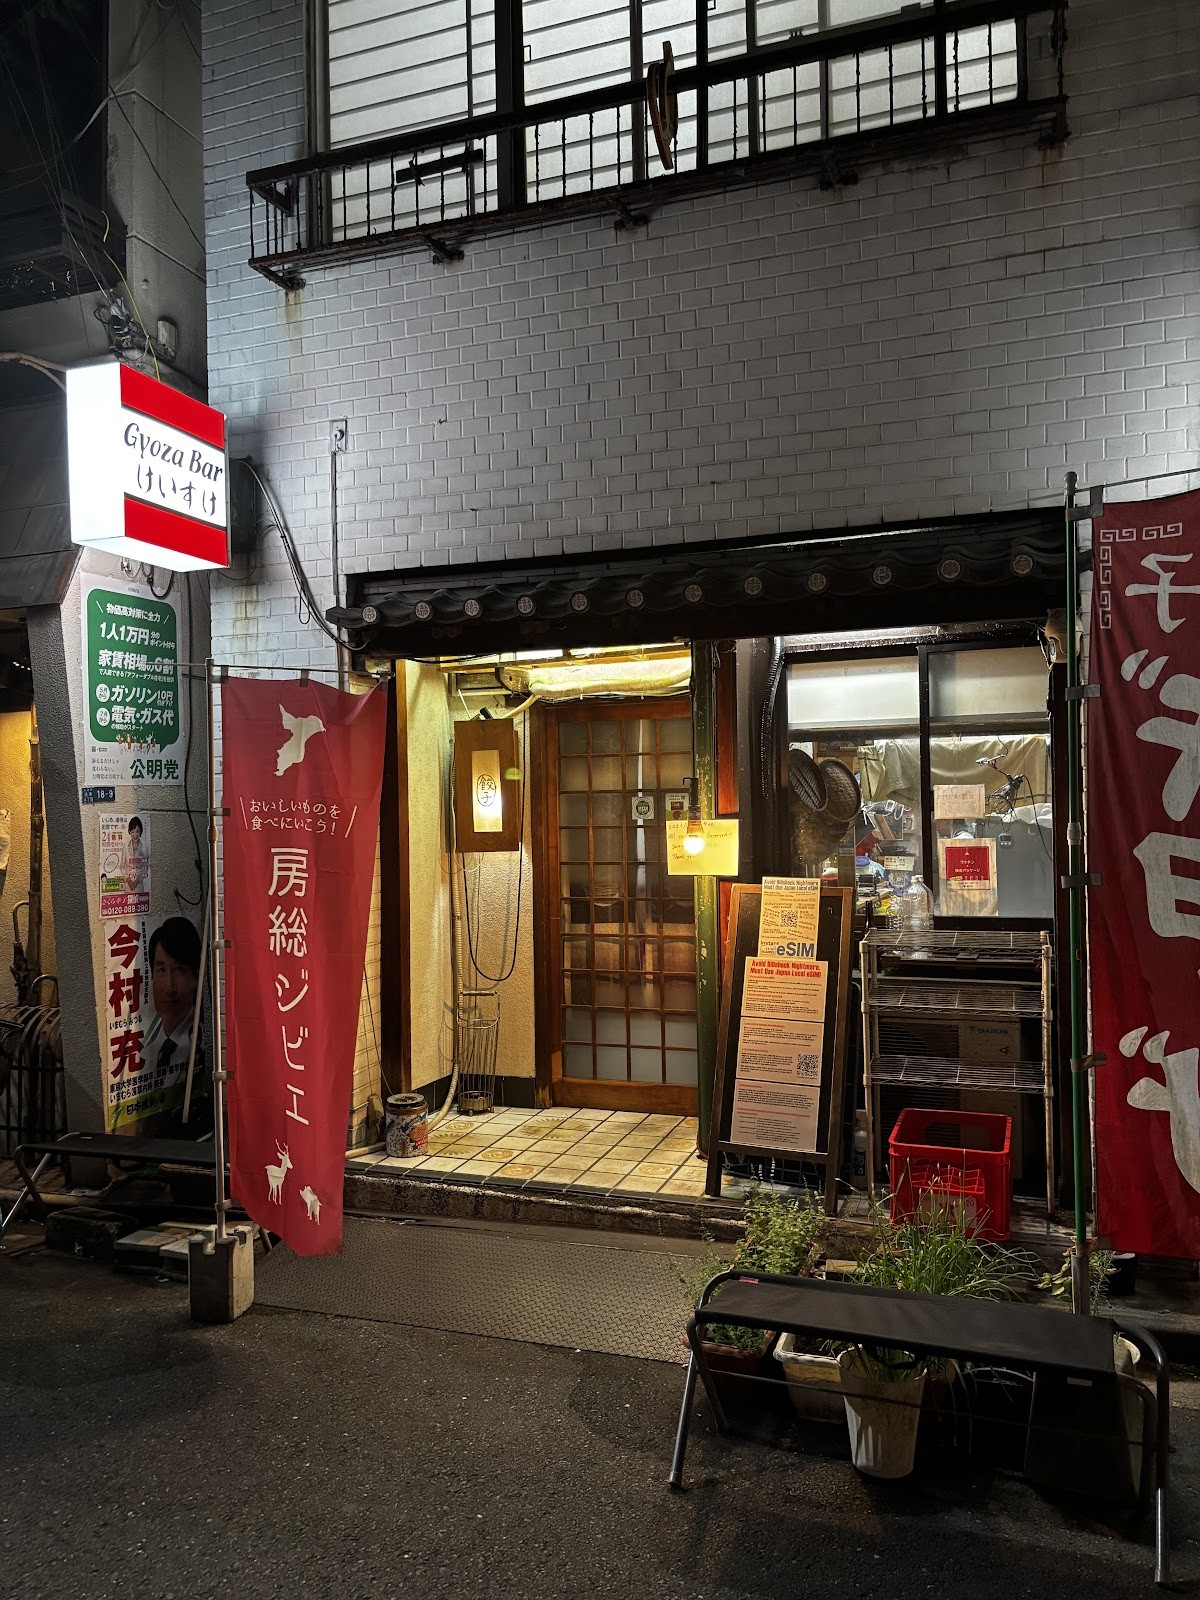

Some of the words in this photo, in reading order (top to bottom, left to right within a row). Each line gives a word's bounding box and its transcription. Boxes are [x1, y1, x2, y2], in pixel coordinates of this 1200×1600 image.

[124, 422, 184, 468] Gyoza
[189, 449, 223, 482] Bar
[137, 463, 217, 517] けいすけ
[106, 602, 161, 622] 物価高対策に全力
[100, 622, 150, 646] 1人1万円
[110, 684, 157, 704] ガソリン
[156, 690, 174, 701] 10円
[111, 705, 174, 727] 電気・ガス代
[130, 758, 180, 780] 公明党
[96, 790, 114, 798] 18-9
[478, 776, 494, 804] 餃子
[249, 798, 342, 818] おいしいものを
[251, 815, 338, 836] 食べにいこう!
[108, 904, 148, 915] 0120-089-390
[776, 942, 814, 958] eSIM
[775, 969, 791, 977] Japan
[268, 846, 310, 1126] 房総ジビエ
[110, 1014, 143, 1030] いまむらみつる
